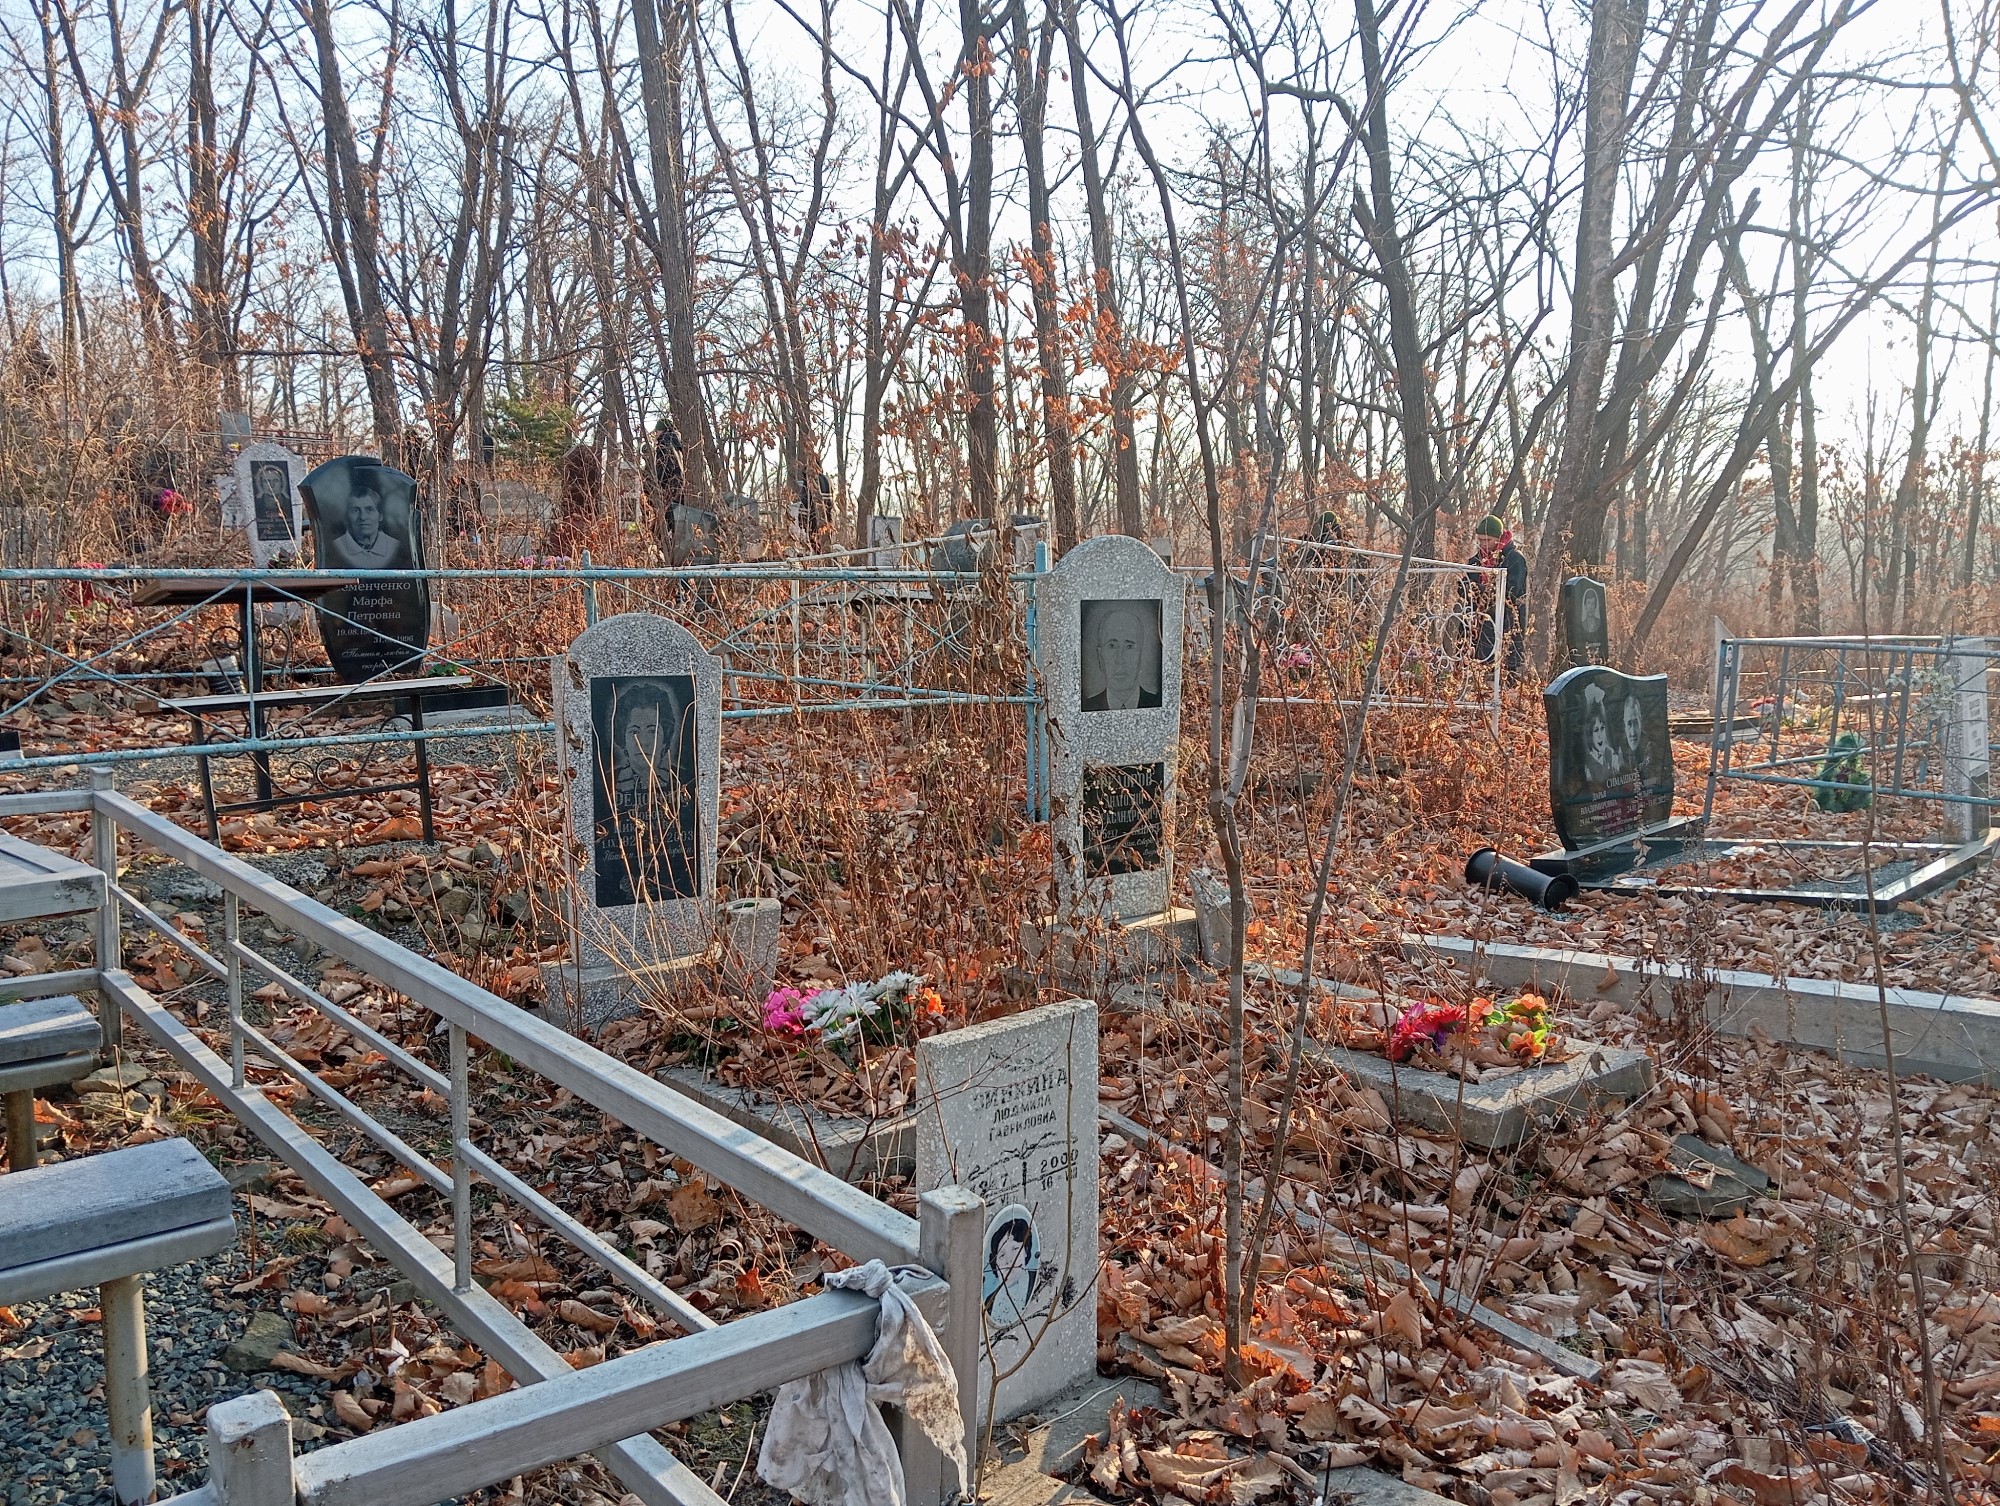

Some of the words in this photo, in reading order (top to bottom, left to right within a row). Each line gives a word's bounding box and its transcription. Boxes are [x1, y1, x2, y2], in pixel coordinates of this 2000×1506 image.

[337, 582, 411, 592] еменченко
[352, 596, 393, 607] Марфа
[347, 611, 401, 622] Петровна
[993, 1095, 1052, 1124] ЛЮДМИЛА
[989, 1110, 1057, 1142] ГАВРИЛОВНА
[1041, 1149, 1079, 1174] 2000
